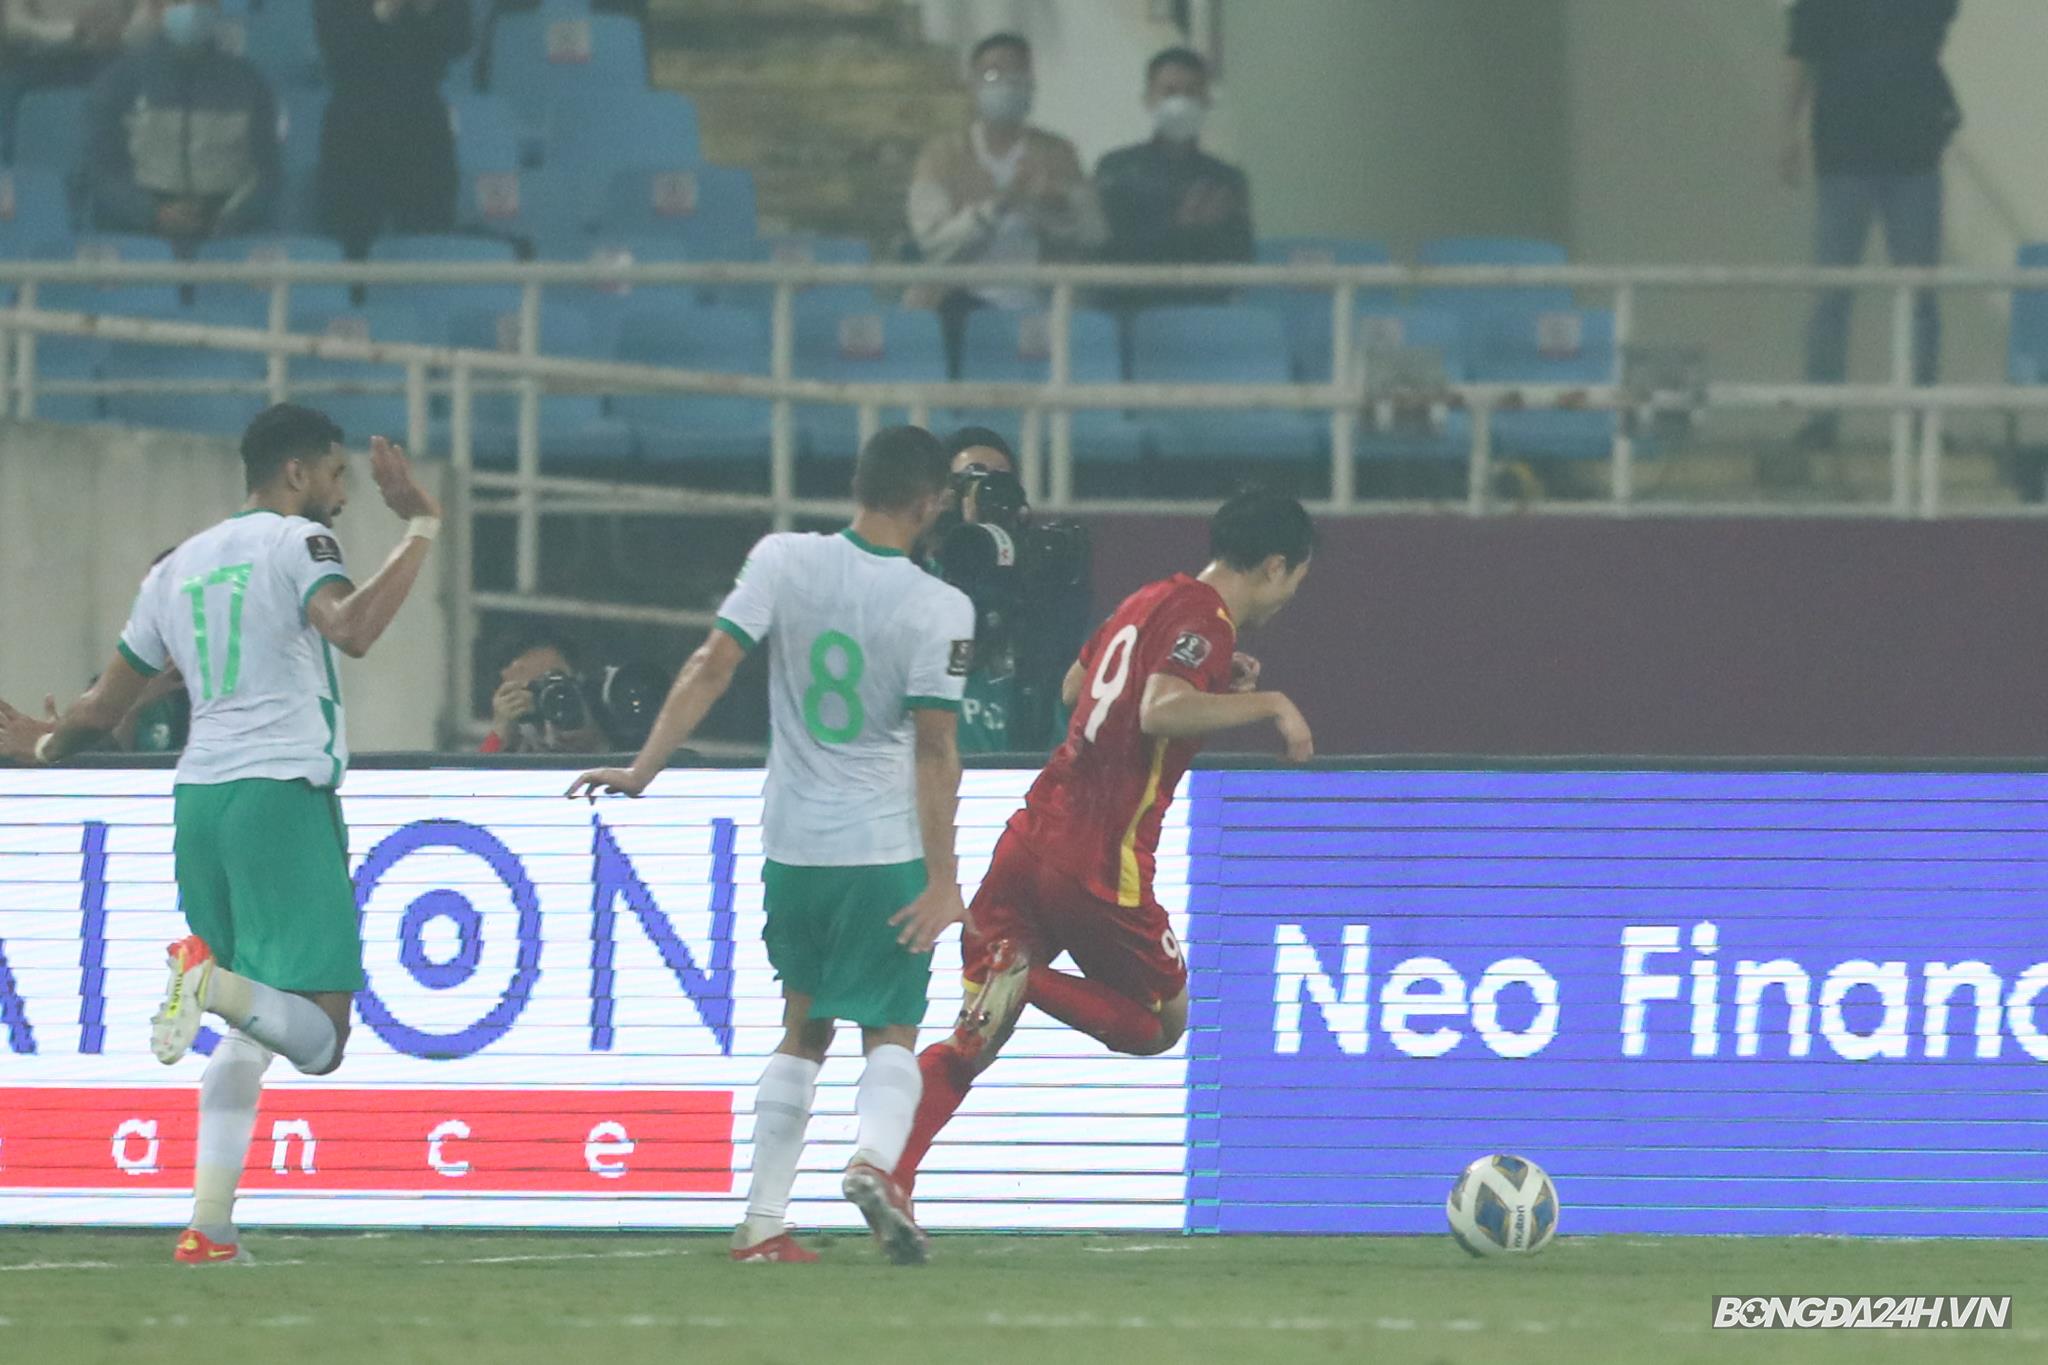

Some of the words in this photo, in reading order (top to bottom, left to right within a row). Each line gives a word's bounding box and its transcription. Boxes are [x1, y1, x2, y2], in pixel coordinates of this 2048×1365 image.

[181, 561, 253, 700] 17
[803, 628, 865, 744] 8
[1084, 624, 1138, 743] 9
[1273, 924, 1560, 1058] Neo
